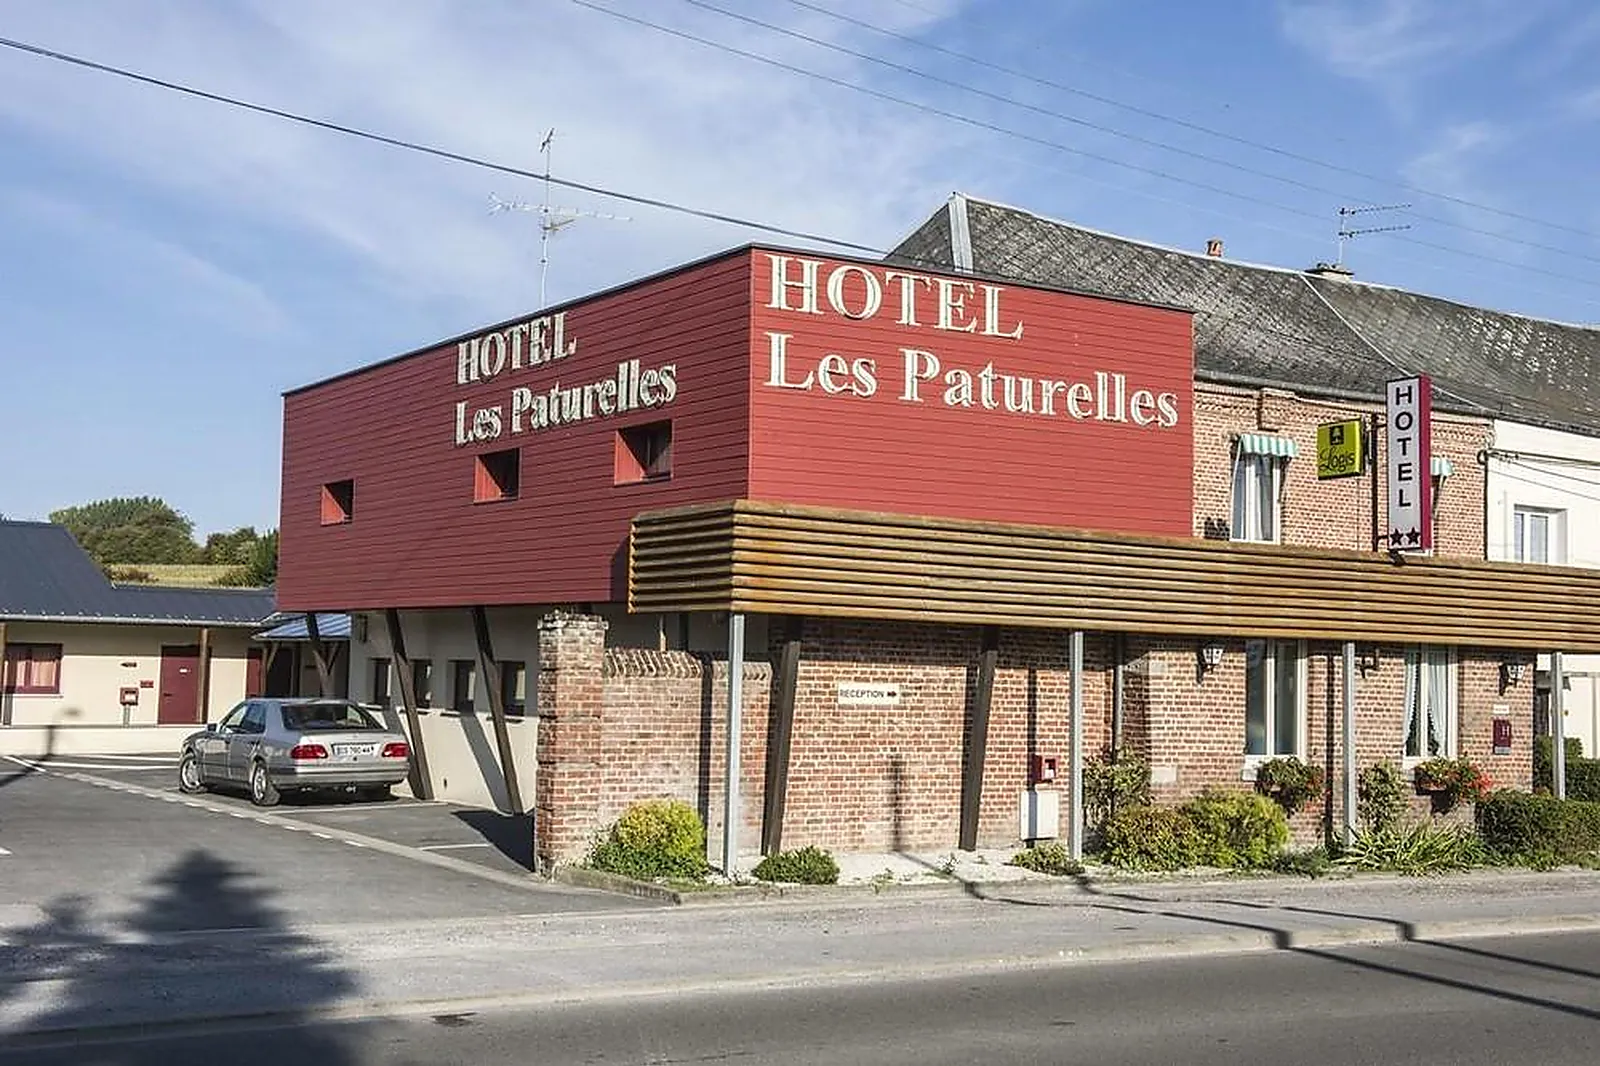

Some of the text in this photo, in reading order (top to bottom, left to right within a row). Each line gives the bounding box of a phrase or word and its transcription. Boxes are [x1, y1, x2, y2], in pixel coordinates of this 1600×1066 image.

[765, 253, 1024, 341] HOTEL
[457, 311, 577, 385] HOTEL
[763, 331, 1179, 428] Les Paturelles
[455, 358, 678, 446] Les Paturelles
[1395, 385, 1413, 507] HOTEL
[1318, 447, 1356, 473] Logis
[839, 689, 885, 698] RECEPTION
